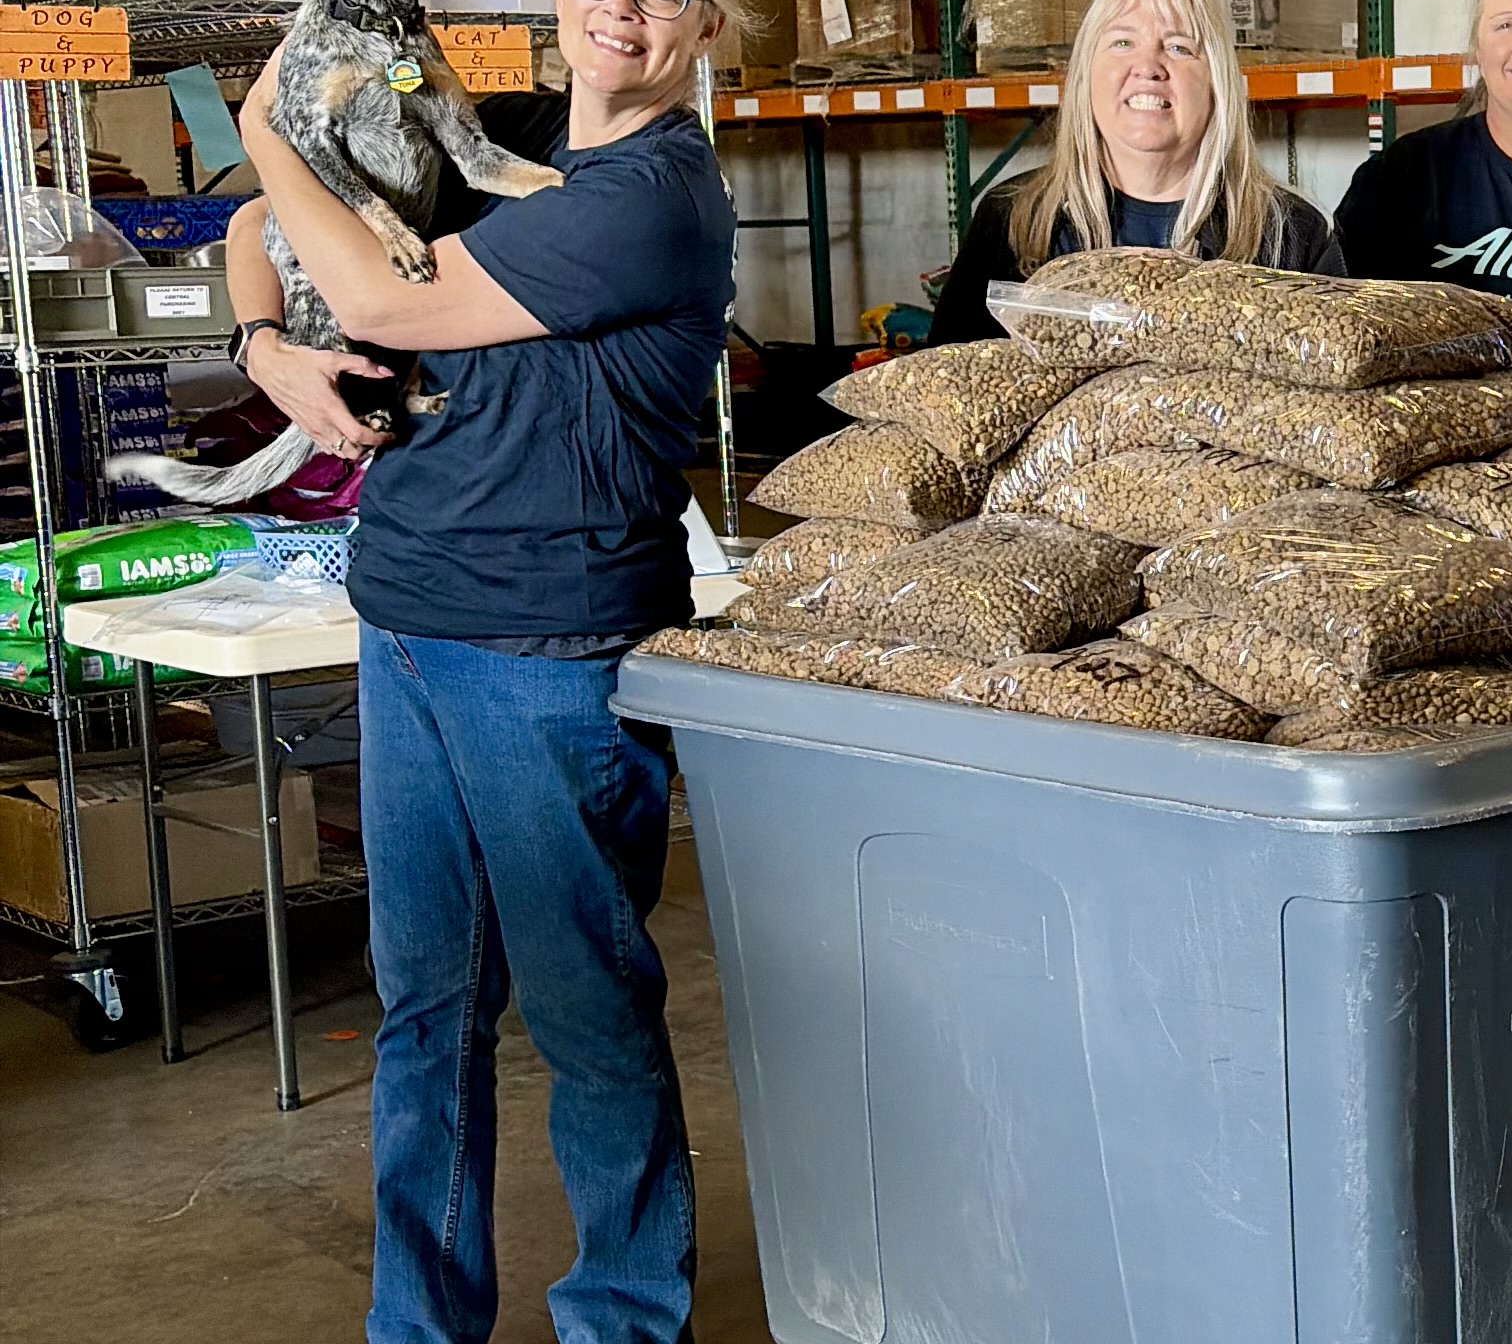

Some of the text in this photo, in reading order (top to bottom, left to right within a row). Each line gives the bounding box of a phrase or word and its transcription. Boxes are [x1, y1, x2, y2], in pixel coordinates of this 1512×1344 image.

[31, 10, 93, 27] DOG
[56, 35, 73, 52] &
[454, 30, 501, 46] CAT
[19, 57, 114, 74] PUPPY
[471, 51, 485, 67] &
[464, 71, 525, 87] TTEN
[108, 373, 146, 387] AMS
[110, 407, 149, 422] AMS
[120, 554, 189, 582] IAMS
